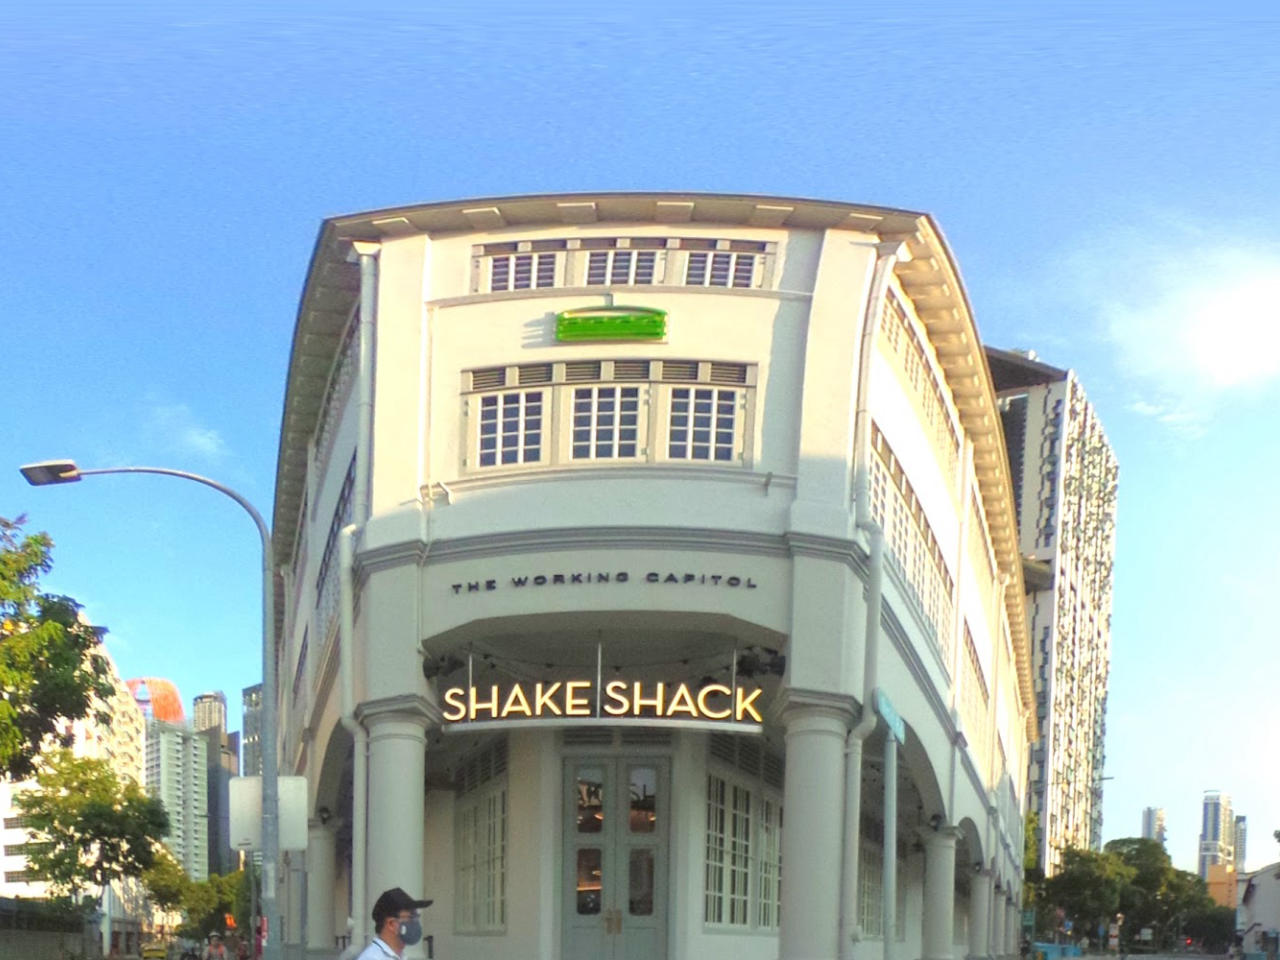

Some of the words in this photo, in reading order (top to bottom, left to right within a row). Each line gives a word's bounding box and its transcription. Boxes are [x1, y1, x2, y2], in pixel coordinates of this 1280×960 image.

[451, 579, 496, 595] THE
[511, 571, 629, 587] WORKING
[645, 571, 758, 589] CAPITOL
[442, 681, 592, 722] SHAKE
[603, 680, 763, 723] SHACK
